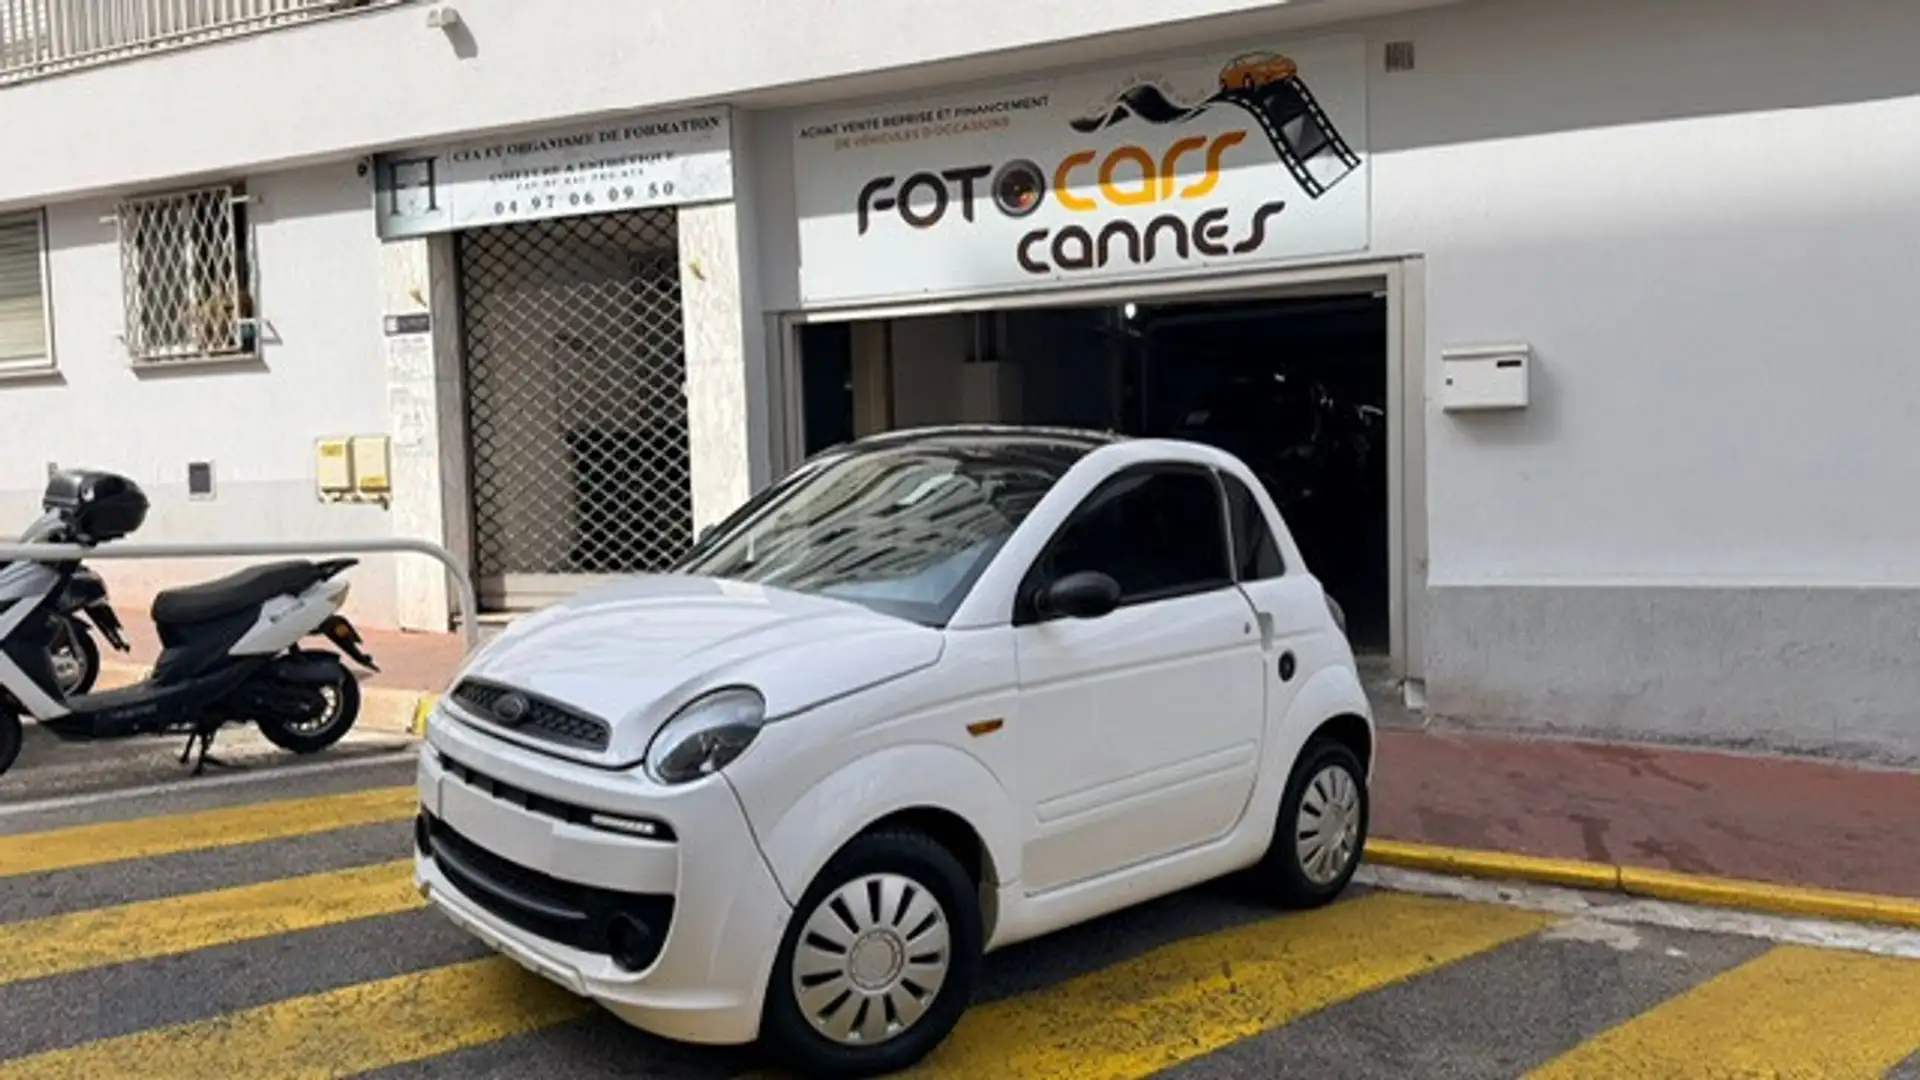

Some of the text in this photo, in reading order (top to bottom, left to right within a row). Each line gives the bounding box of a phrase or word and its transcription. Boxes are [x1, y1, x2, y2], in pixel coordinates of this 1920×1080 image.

[841, 116, 879, 133] VENTE
[936, 107, 952, 122] ET
[955, 95, 1048, 117] FINANCEMENT
[506, 131, 594, 154] ORGANISME
[599, 130, 619, 143] DE
[623, 115, 719, 140] FORMATION
[494, 199, 518, 216] 04
[531, 195, 555, 210] 97
[569, 190, 595, 206] 06
[607, 185, 634, 202] 09
